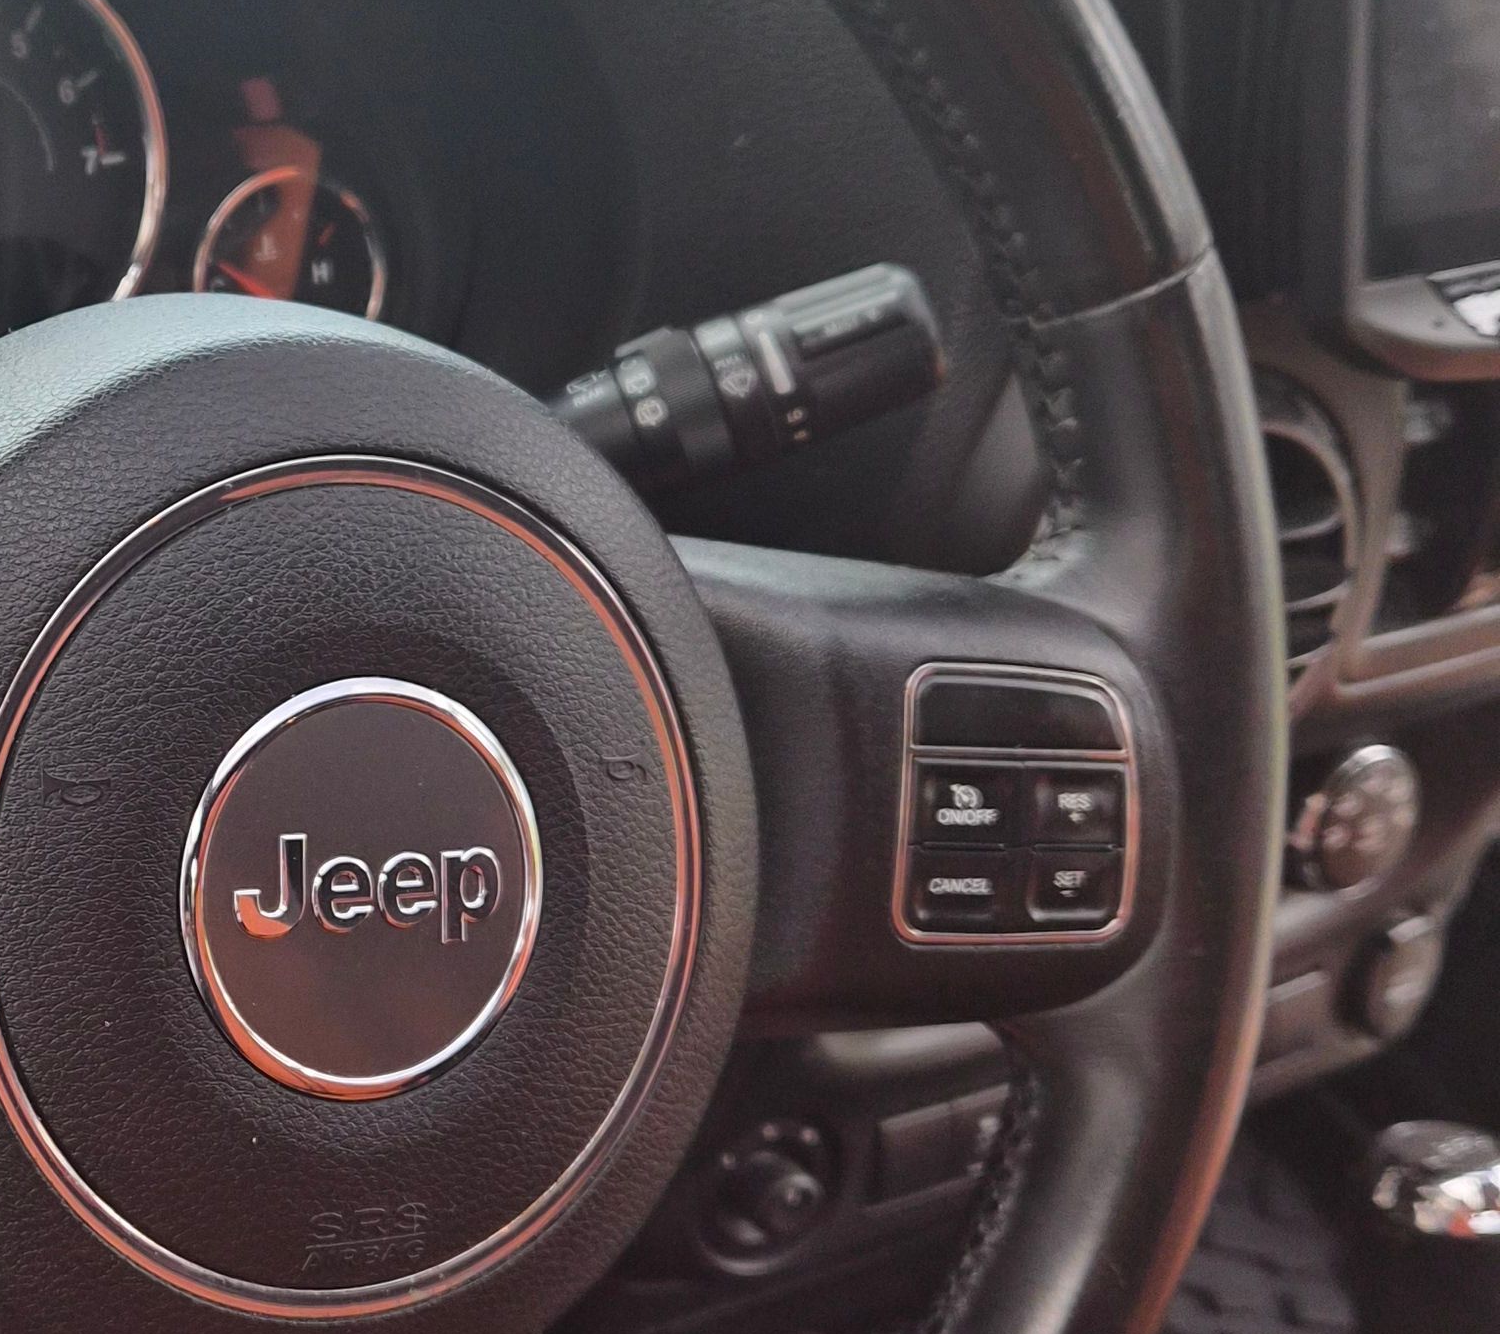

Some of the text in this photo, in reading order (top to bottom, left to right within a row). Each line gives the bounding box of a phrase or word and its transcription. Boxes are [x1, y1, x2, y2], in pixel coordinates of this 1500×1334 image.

[233, 832, 502, 944] Jeep
[928, 877, 995, 895] CANCEL
[1053, 870, 1087, 888] SET
[307, 1201, 431, 1241] SRS
